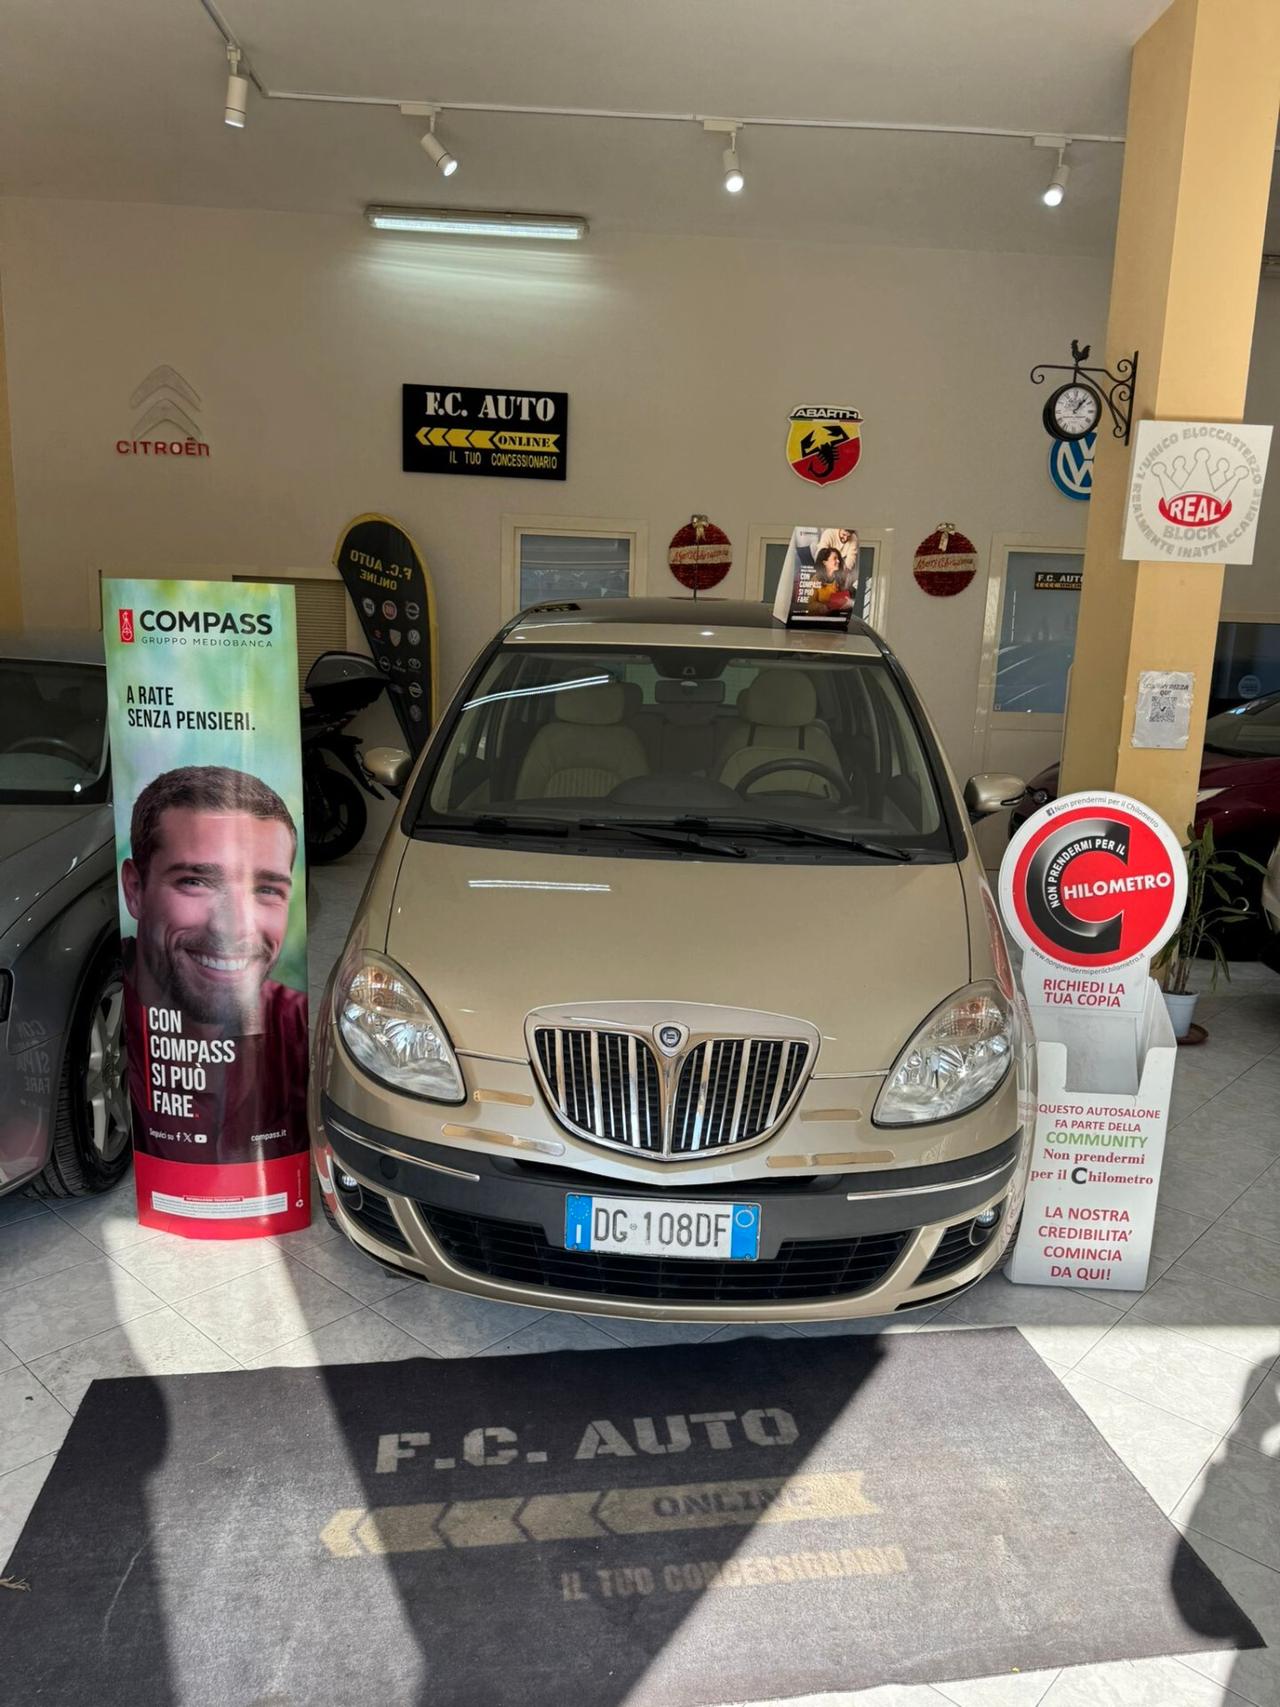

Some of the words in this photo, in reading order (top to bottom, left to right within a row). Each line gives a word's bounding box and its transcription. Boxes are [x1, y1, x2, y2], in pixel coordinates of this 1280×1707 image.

[425, 391, 468, 417] F.C.
[478, 395, 555, 422] AUTO
[795, 408, 857, 418] ABARTH
[498, 434, 551, 448] ONLINE
[449, 450, 457, 464] IL
[464, 451, 481, 465] TUO
[491, 453, 557, 469] CONCESSIONARIO
[1137, 433, 1179, 479] L'UNICO
[1182, 426, 1262, 485] BLOCCASTERZO
[1169, 496, 1220, 523] REAL
[1132, 483, 1175, 554] REALMENTE
[1177, 489, 1261, 558] INATTACCABILE
[1162, 525, 1220, 541] BLOCK
[140, 609, 273, 635] COMPASS
[141, 636, 187, 645] GRUPPO
[193, 638, 273, 648] MEDIOBANCA
[127, 685, 135, 704] A
[138, 686, 174, 706] RATE
[127, 708, 172, 729] SENZA
[176, 711, 256, 731] PENSIERI.
[1054, 802, 1070, 813] Non
[1070, 796, 1107, 807] prendermi
[1107, 798, 1120, 806] per
[1120, 799, 1126, 808] il
[1126, 801, 1159, 828] Chilometro
[1095, 838, 1116, 851] PER
[1116, 843, 1126, 856] IL
[1048, 838, 1093, 884] PRENDERMI
[1047, 884, 1060, 909] NON
[1043, 978, 1105, 994] RICHIEDI
[1108, 982, 1126, 995] LA
[1044, 991, 1073, 1005] TUA
[1077, 994, 1121, 1007] COPIA
[149, 1006, 182, 1033] CON
[149, 1035, 236, 1063] COMPASS
[151, 1062, 166, 1087] SI
[170, 1063, 207, 1091] PUÒ
[1038, 1103, 1084, 1115] QUESTO
[1086, 1106, 1161, 1119] AUTOSALONE
[251, 1129, 287, 1142] compass.it
[1054, 1119, 1068, 1129] FA
[1071, 1120, 1105, 1131] PARTE
[1108, 1122, 1141, 1133] DELLA
[1046, 1131, 1149, 1148] COMMUNITY
[1043, 1148, 1070, 1161] Non
[1074, 1150, 1145, 1165] prendermi
[1030, 1170, 1053, 1182] per
[1057, 1169, 1067, 1180] il
[1071, 1166, 1153, 1185] Chilometro
[1045, 1206, 1063, 1219] LA
[1068, 1207, 1130, 1222] NOSTRA
[593, 1207, 628, 1243] DG
[643, 1211, 730, 1248] 108DF
[1038, 1225, 1133, 1242] CREDIBILITA'
[1043, 1245, 1122, 1262] COMINCIA
[1050, 1265, 1072, 1278] DA
[1076, 1267, 1111, 1281] QUI!
[374, 1426, 548, 1474] F.C.
[574, 1407, 800, 1460] AUTO
[561, 1571, 589, 1601] IL
[597, 1567, 654, 1598] TUO
